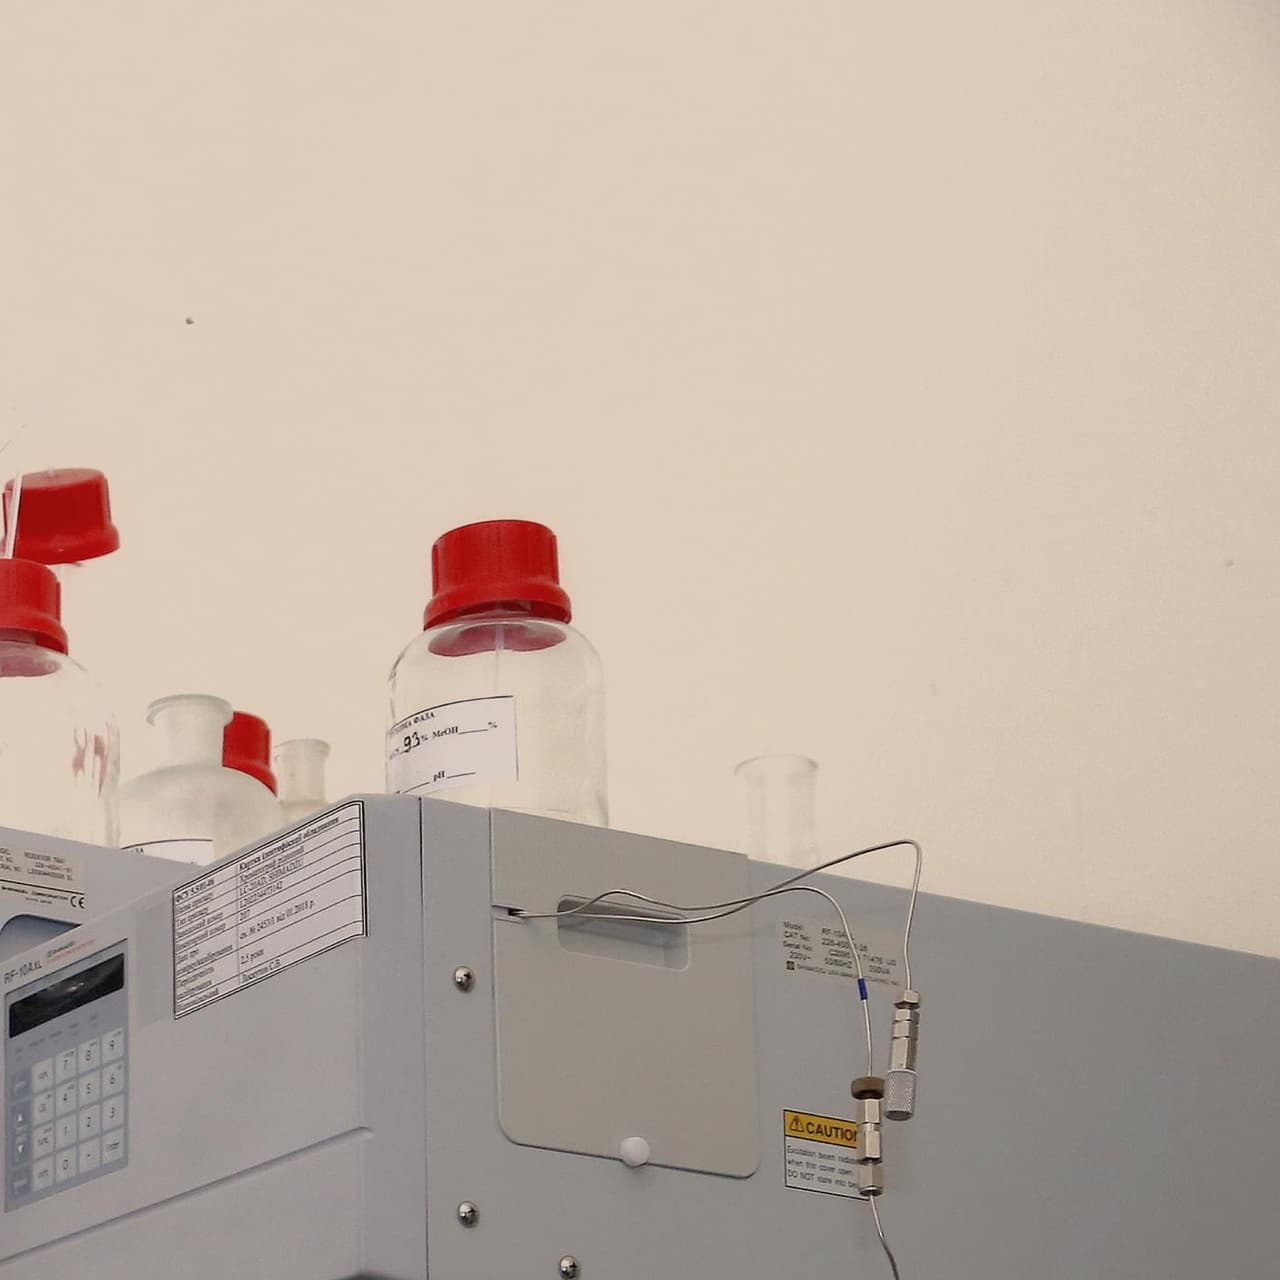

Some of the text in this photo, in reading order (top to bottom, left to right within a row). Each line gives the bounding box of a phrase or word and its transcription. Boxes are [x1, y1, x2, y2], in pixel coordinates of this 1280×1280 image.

[432, 725, 459, 738] MeOH
[403, 731, 421, 753] 93
[433, 770, 445, 782] pH
[806, 1121, 857, 1142] CAUTIO
